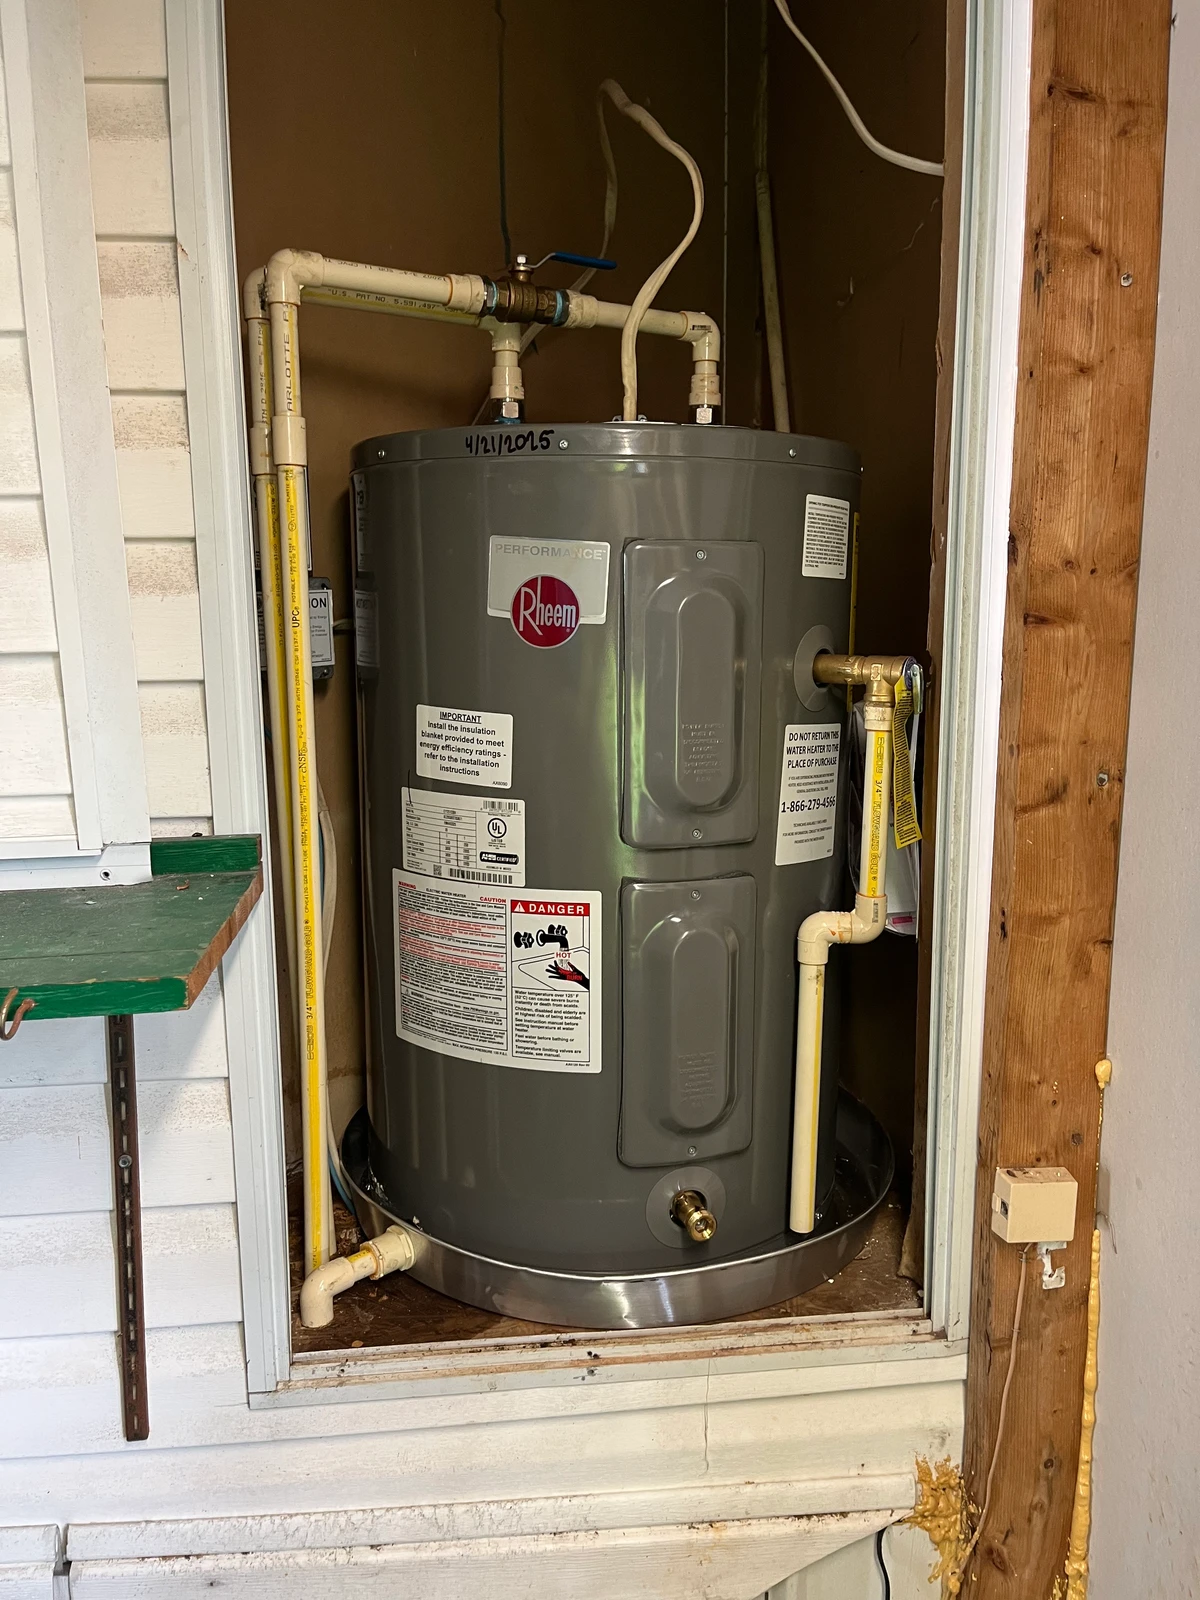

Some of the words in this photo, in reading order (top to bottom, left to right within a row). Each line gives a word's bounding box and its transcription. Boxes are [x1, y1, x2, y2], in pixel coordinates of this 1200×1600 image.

[356, 293, 371, 301] PAT
[465, 429, 555, 456] 4/21/2025
[519, 576, 577, 636] Rheem
[291, 609, 301, 629] UPC
[440, 711, 481, 722] IMPORTANT
[428, 721, 446, 730] Install
[448, 723, 458, 732] the
[460, 725, 496, 736] insulation
[422, 730, 443, 740] blanket
[445, 735, 474, 744] provided
[789, 732, 798, 742] DO
[800, 732, 811, 741] NOT
[812, 732, 830, 740] RETURN
[830, 730, 839, 739] THIS
[420, 742, 440, 751] energy
[441, 744, 473, 756] efficiency
[476, 748, 501, 758] ratings
[786, 746, 806, 755] WATER
[807, 745, 825, 754] HEATER
[826, 744, 832, 753] TO
[460, 757, 499, 768] installation
[788, 759, 806, 768] PLACE
[807, 758, 814, 768] OF
[815, 756, 837, 767] PURCHASE
[440, 764, 480, 776] instructions
[781, 796, 836, 813] 1-866-279-4566
[491, 821, 502, 835] UL
[529, 904, 584, 914] DANGER
